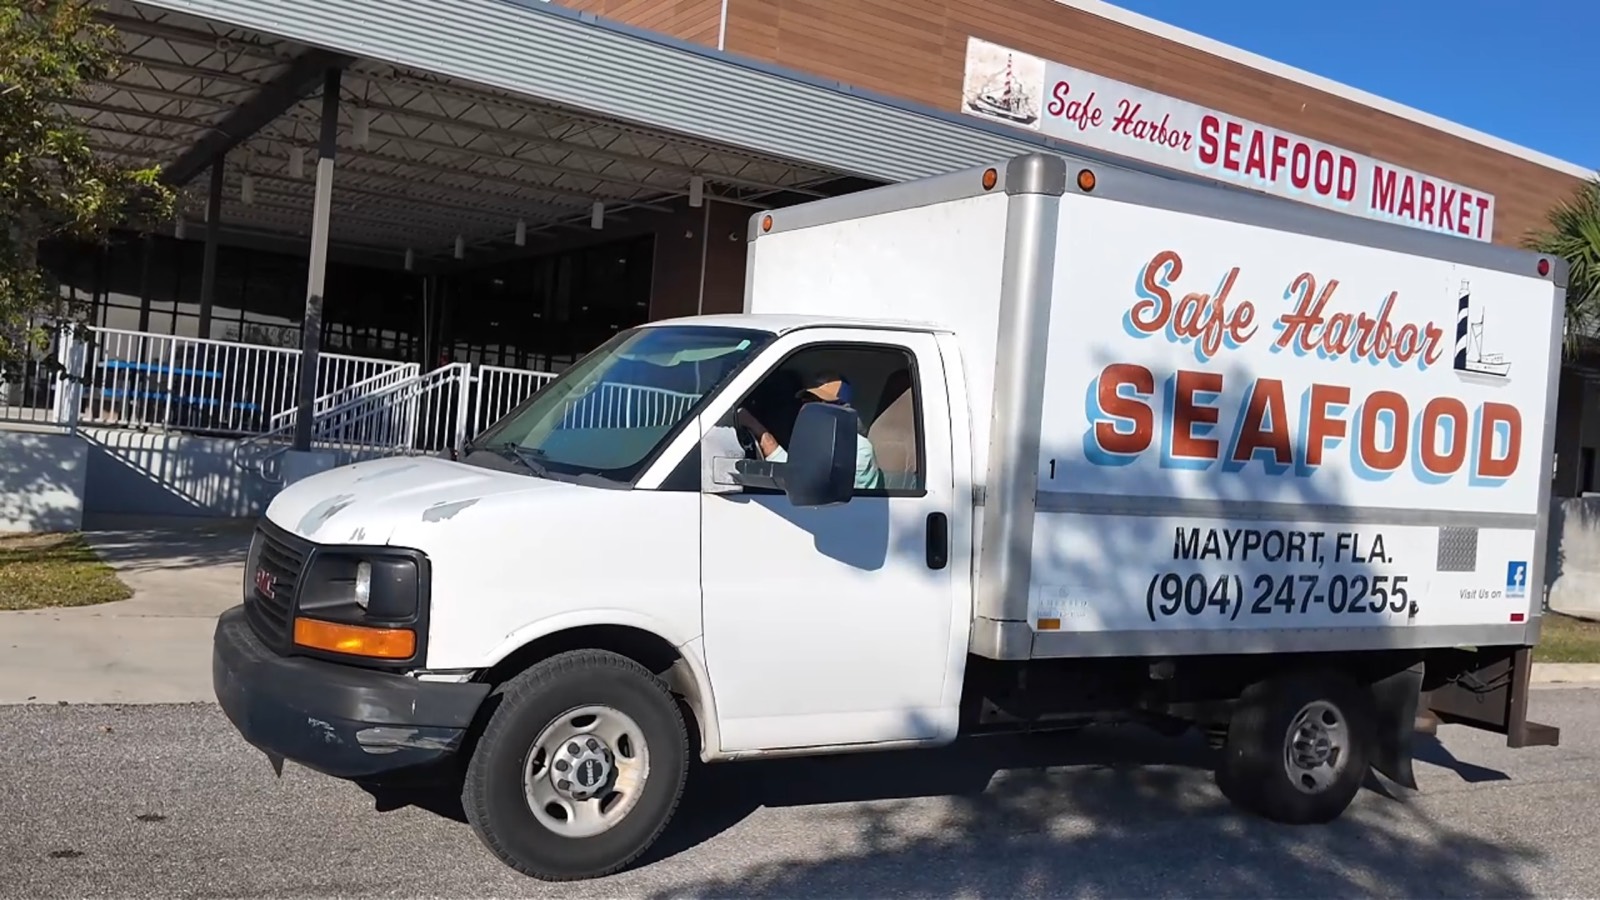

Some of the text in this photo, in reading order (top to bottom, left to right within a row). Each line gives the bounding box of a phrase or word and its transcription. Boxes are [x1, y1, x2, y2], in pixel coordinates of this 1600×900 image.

[1047, 81, 1490, 240] Safe Harbor SEAFOOD MARKET
[1129, 249, 1444, 366] Safe Harbor
[1094, 362, 1523, 479] SEAFOOD
[1048, 458, 1056, 480] 1
[1173, 526, 1393, 569] MAYPORT, FLA.
[1146, 572, 1409, 622] (904) 247-0255
[1459, 588, 1477, 599] Visit
[1478, 588, 1489, 600] Us
[1490, 590, 1502, 599] on
